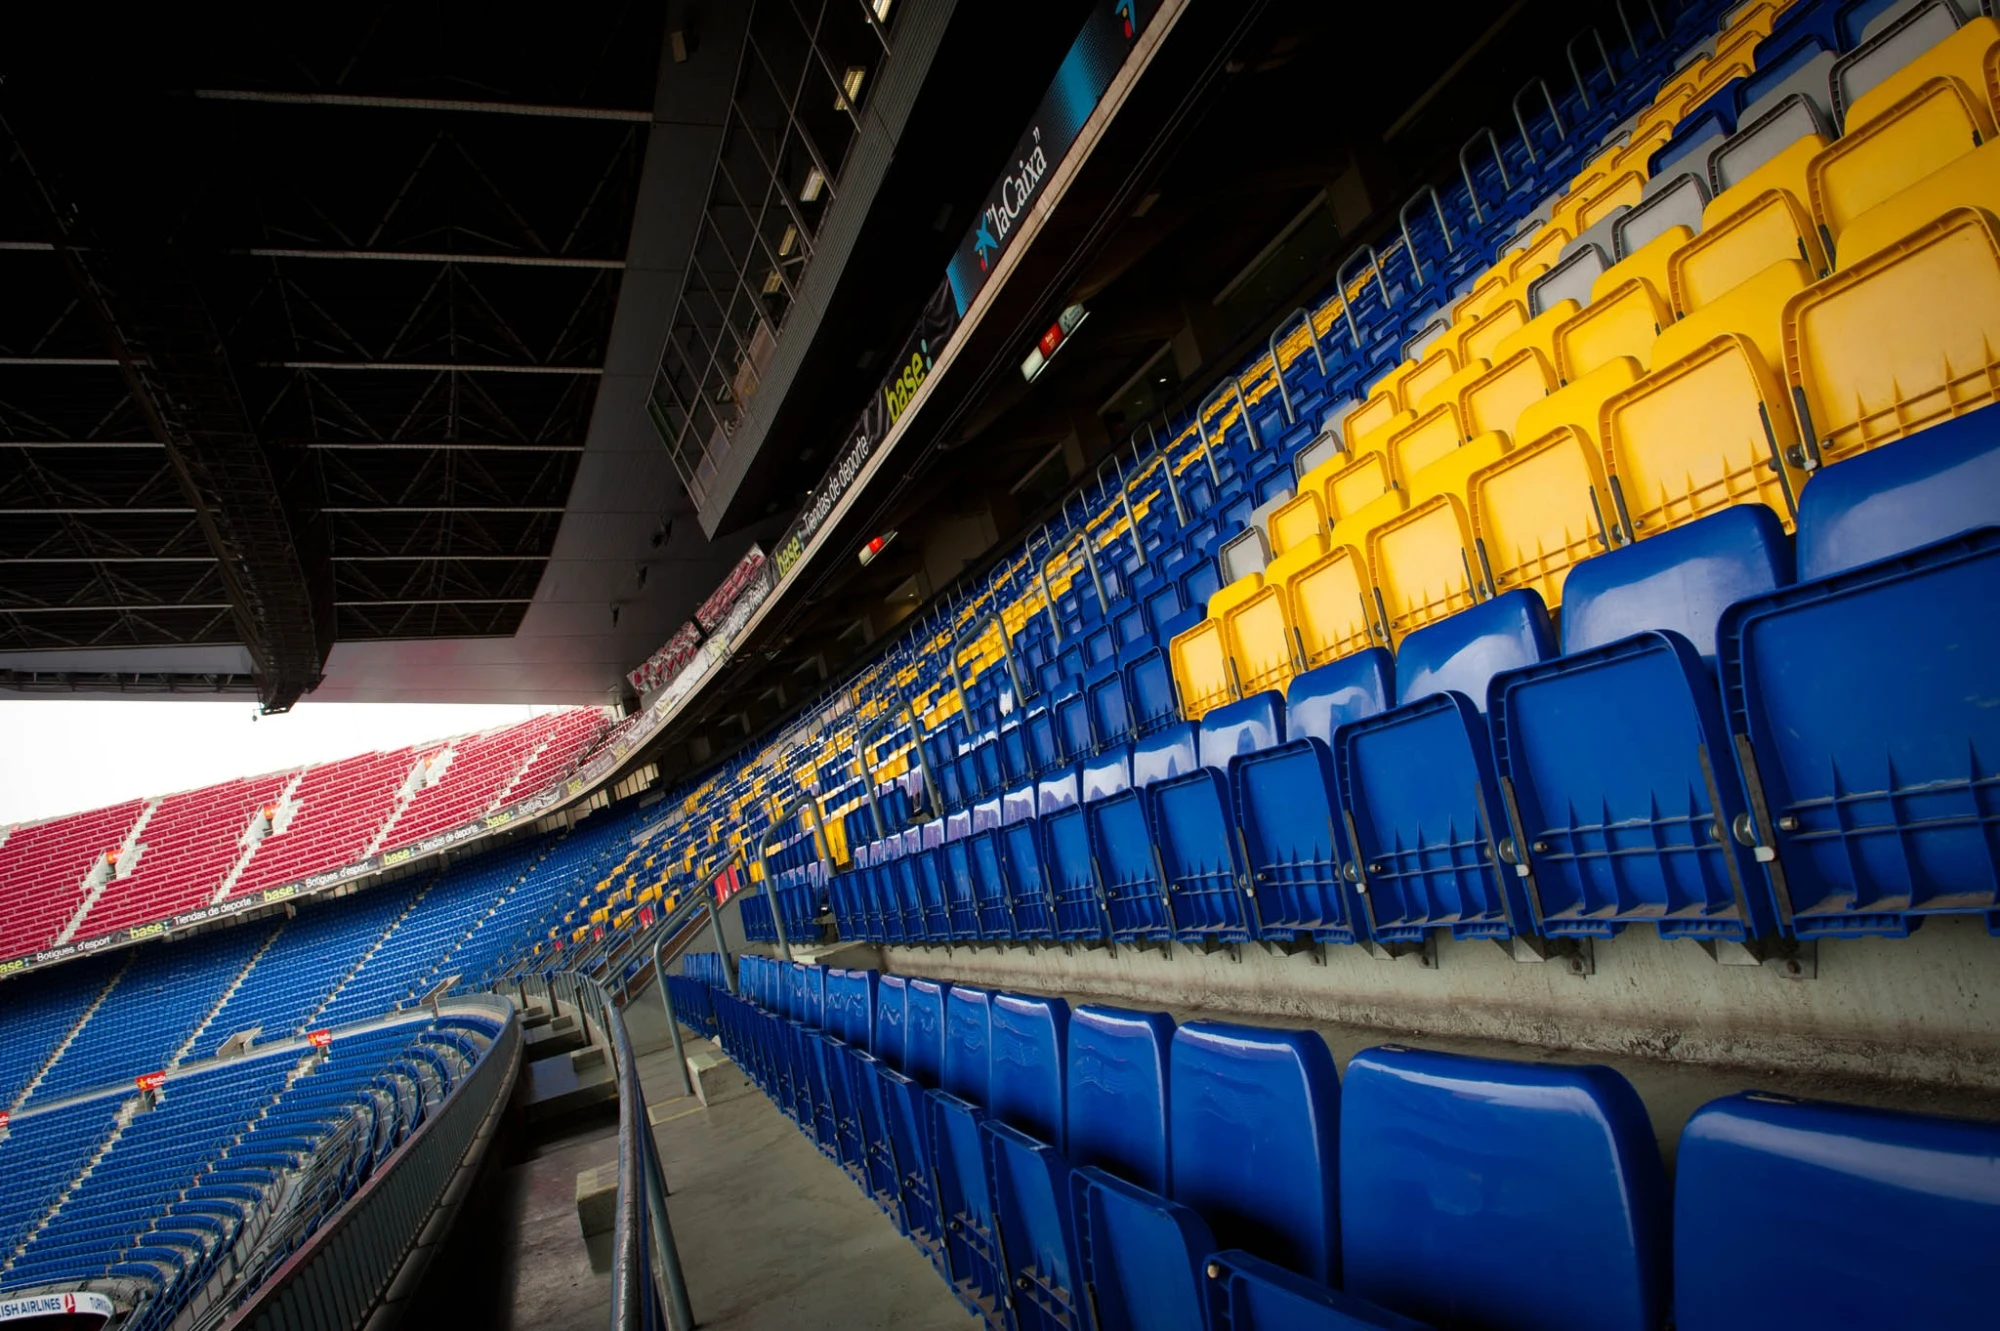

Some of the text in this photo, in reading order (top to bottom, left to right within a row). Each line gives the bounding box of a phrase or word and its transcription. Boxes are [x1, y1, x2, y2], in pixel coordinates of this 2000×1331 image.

[802, 492, 831, 536] Tiendas
[829, 476, 841, 502] de
[838, 435, 869, 482] deporte
[445, 833, 455, 843] de
[173, 910, 207, 925] Tiendas
[208, 907, 220, 917] de
[221, 898, 252, 912] deporte
[36, 946, 75, 962] Botigues
[77, 935, 110, 951] d'esport
[0, 1298, 61, 1318] ISH AIRLINES
